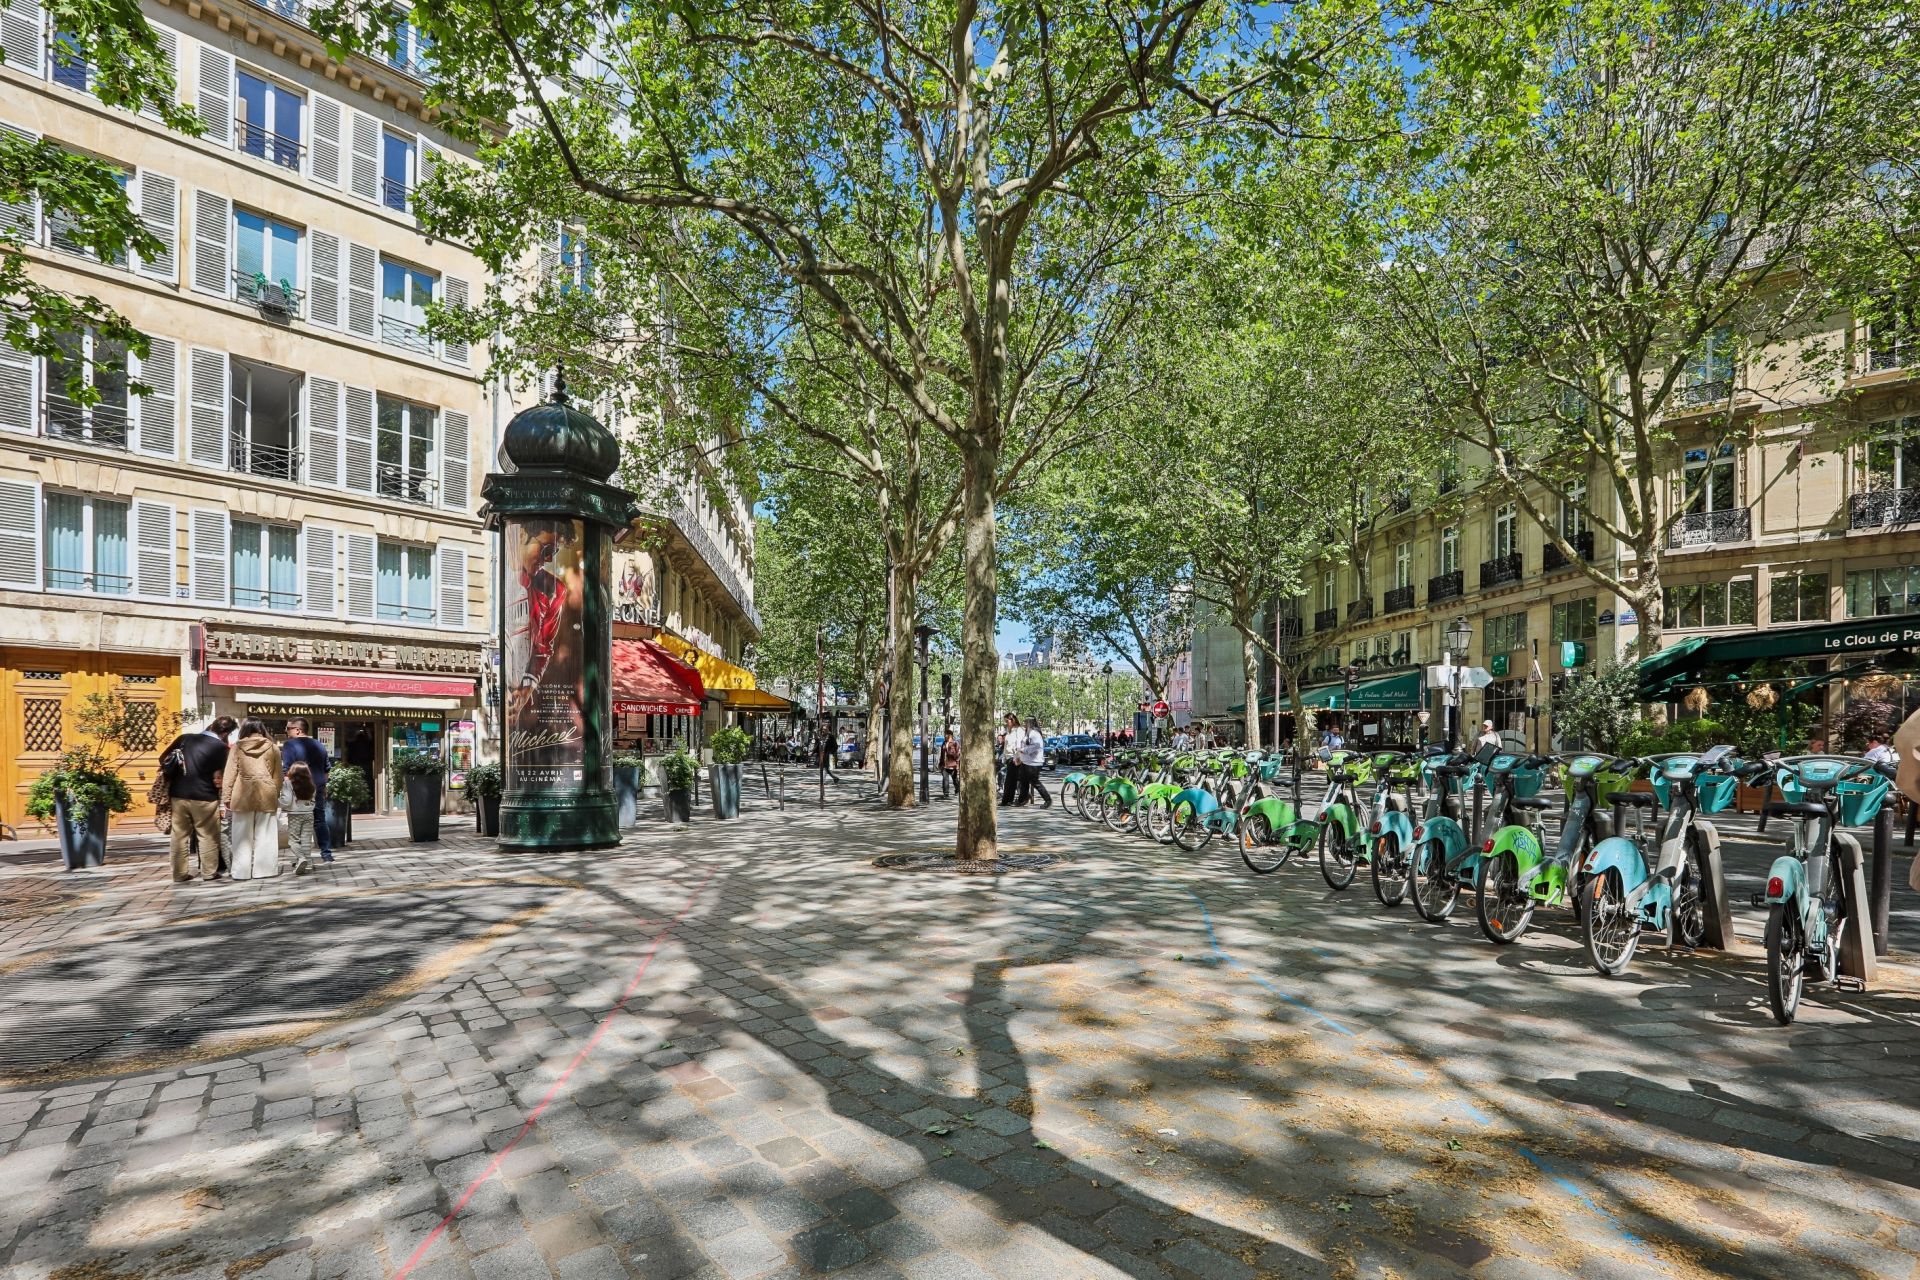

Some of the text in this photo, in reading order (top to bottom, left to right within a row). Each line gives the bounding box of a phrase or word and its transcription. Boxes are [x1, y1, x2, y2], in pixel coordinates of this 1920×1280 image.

[505, 488, 557, 498] SPECTACLES
[1825, 638, 1840, 648] Le
[1844, 635, 1876, 646] Clou
[1880, 631, 1898, 642] de
[213, 631, 298, 655] TABAC
[312, 639, 382, 661] SAINT
[396, 644, 480, 667] MICHEL
[302, 678, 424, 692] TABAC SAINT MICHEL
[248, 705, 277, 714] CAVE
[279, 706, 287, 714] A
[288, 706, 336, 716] CIGARES
[341, 708, 381, 717] TABACS
[620, 702, 668, 713] SANDWICHES
[509, 726, 582, 750] Michael
